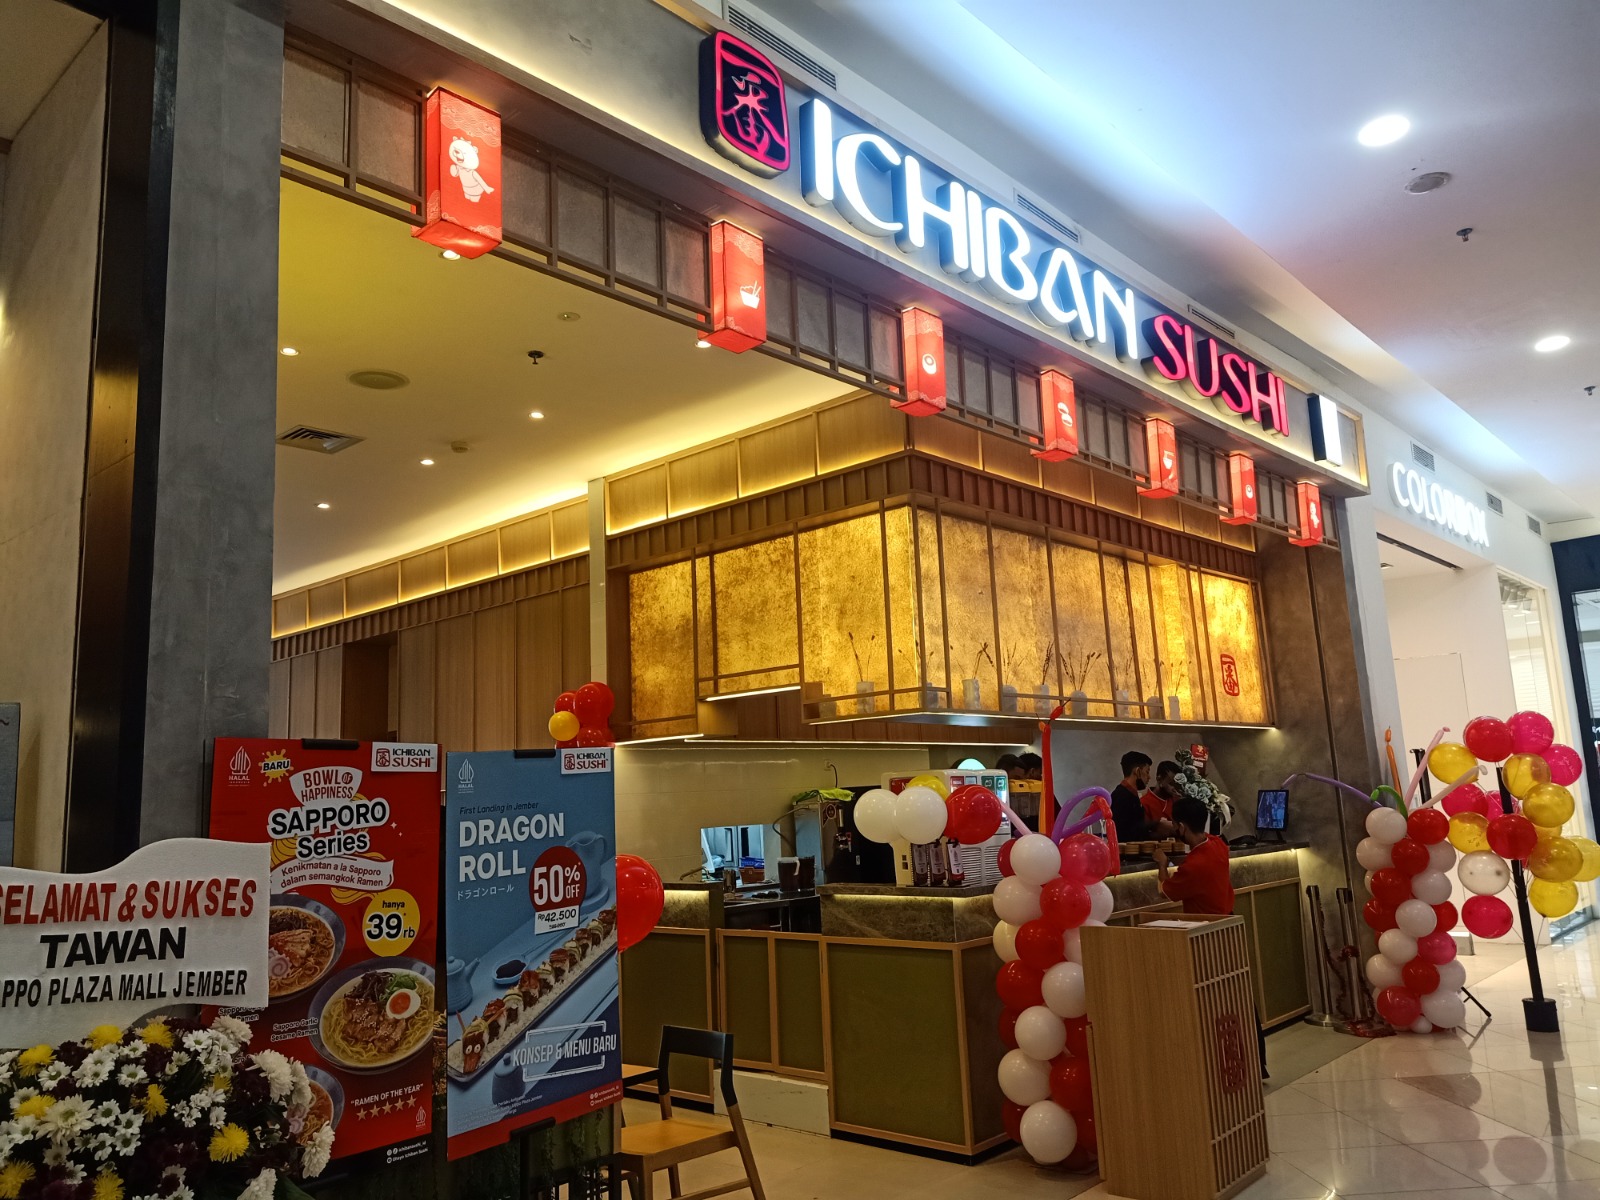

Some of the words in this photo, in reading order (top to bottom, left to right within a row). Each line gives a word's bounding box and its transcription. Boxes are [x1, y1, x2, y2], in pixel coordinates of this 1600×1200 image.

[812, 98, 1139, 360] ICHIBAN
[1150, 313, 1290, 437] SUSHI
[392, 748, 431, 756] ICHIBAN
[576, 752, 606, 760] ICHIBAN
[262, 760, 291, 772] BARU
[392, 757, 430, 768] SUSHI
[576, 760, 606, 770] SUSHI
[302, 769, 341, 788] BOWL
[342, 771, 353, 785] OF
[301, 786, 354, 803] HAPPINESS
[459, 806, 476, 815] First
[477, 804, 505, 815] Landing
[506, 802, 513, 811] in
[513, 802, 539, 811] Jember
[270, 801, 387, 836] SAPPORO
[460, 812, 564, 848] DRAGON
[298, 830, 368, 859] Series
[282, 862, 332, 877] Kenikmatan
[340, 862, 348, 871] la
[349, 864, 381, 879] Sapporo
[459, 850, 526, 882] ROLL
[280, 873, 307, 888] dalam
[308, 872, 355, 884] semangkok
[356, 876, 384, 887] Ramen
[457, 883, 515, 901] ドラゴンロール
[565, 884, 580, 899] OFF
[0, 882, 117, 925] ELAMAT
[118, 884, 138, 923] &
[142, 878, 257, 919] SUKSES
[382, 900, 406, 909] hanya
[40, 926, 187, 969] TAWAN
[48, 974, 114, 1007] PLAZA
[118, 972, 167, 1001] MALL
[172, 970, 248, 998] JEMBER
[273, 1022, 300, 1032] Sapporo
[301, 1018, 318, 1026] Garlic
[270, 1032, 296, 1042] Sesame
[297, 1029, 318, 1037] Ramen
[512, 1044, 552, 1066] KONSEP
[555, 1043, 564, 1058] &
[564, 1038, 591, 1058] MENU
[592, 1034, 617, 1054] BARU
[380, 1092, 390, 1100] OF
[390, 1088, 403, 1098] THE
